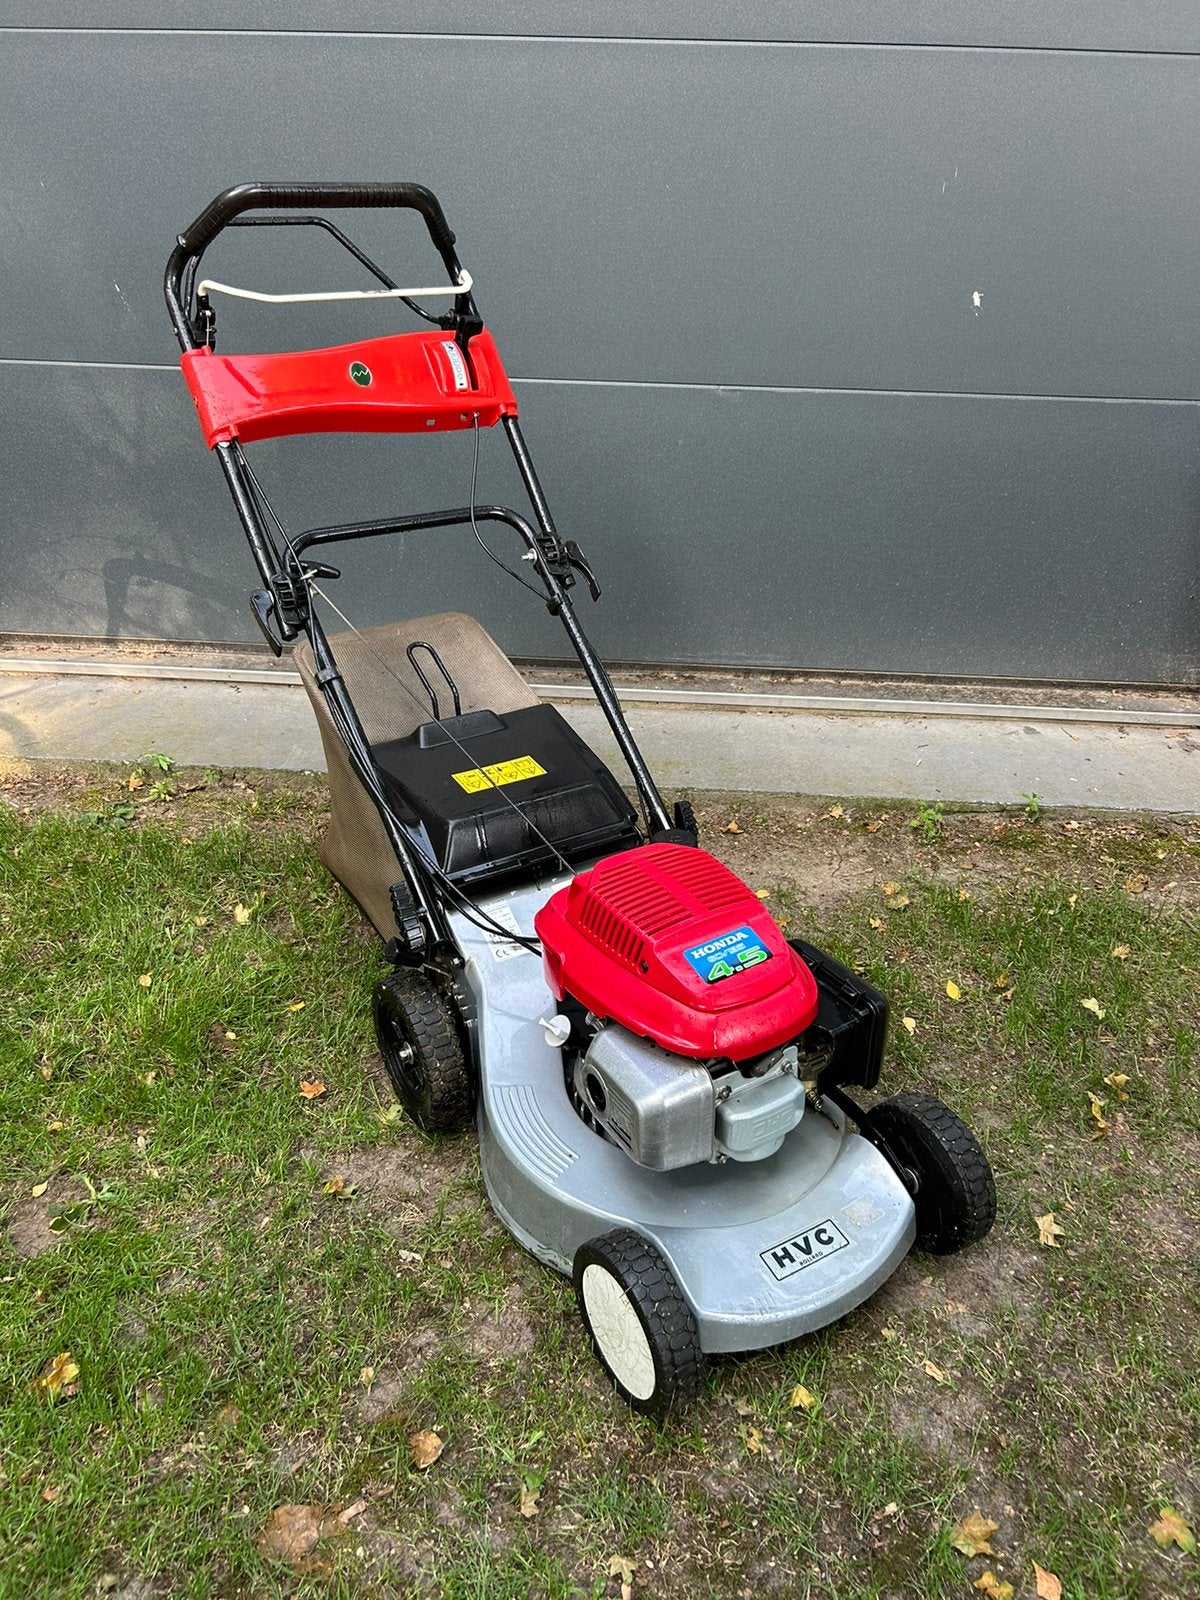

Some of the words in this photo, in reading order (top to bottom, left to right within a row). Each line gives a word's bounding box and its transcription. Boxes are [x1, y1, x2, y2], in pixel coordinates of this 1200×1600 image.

[690, 932, 749, 959] HONDA
[708, 945, 768, 981] 4.5
[771, 1228, 834, 1269] HVC
